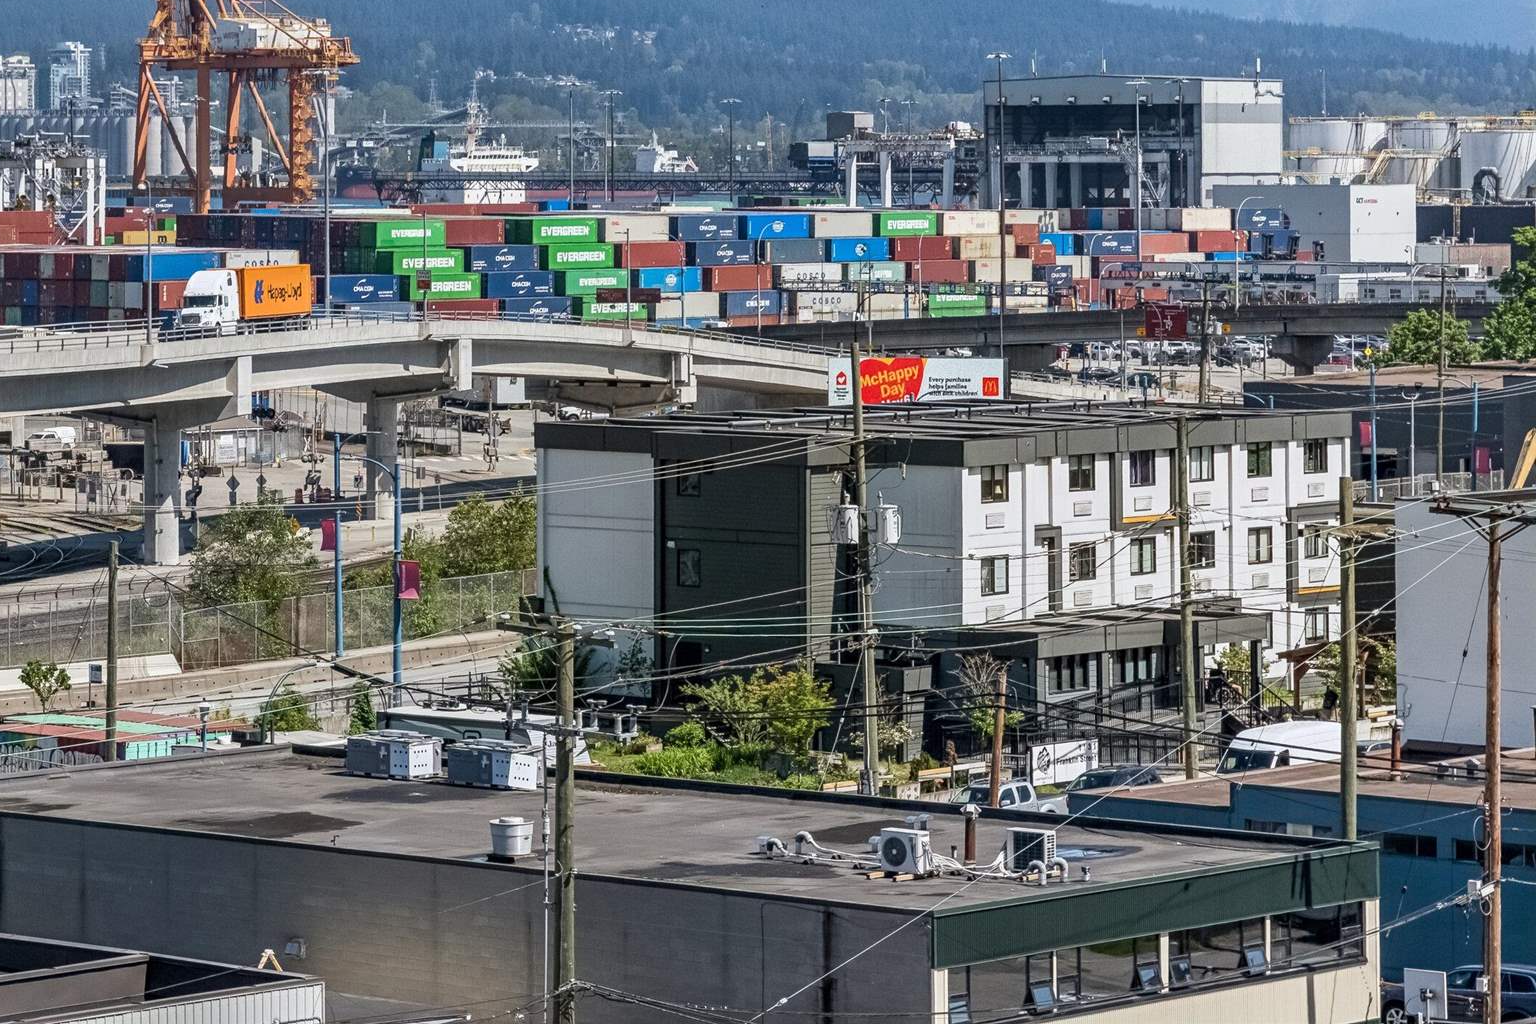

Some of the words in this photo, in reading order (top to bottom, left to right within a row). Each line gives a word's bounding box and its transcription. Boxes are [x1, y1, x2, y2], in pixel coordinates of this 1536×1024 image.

[888, 220, 929, 230] EVERGREEN
[541, 226, 590, 236] EVERGREEN
[557, 251, 606, 262] EVERGREEN
[244, 259, 279, 267] COSCO
[402, 257, 455, 268] EVERGREEN
[797, 272, 825, 280] COSCO
[431, 281, 472, 291] ERGREEN
[579, 277, 616, 286] EVERGREEN
[591, 303, 639, 314] EVERGREEN
[860, 365, 919, 388] McHappy
[880, 383, 906, 398] Day
